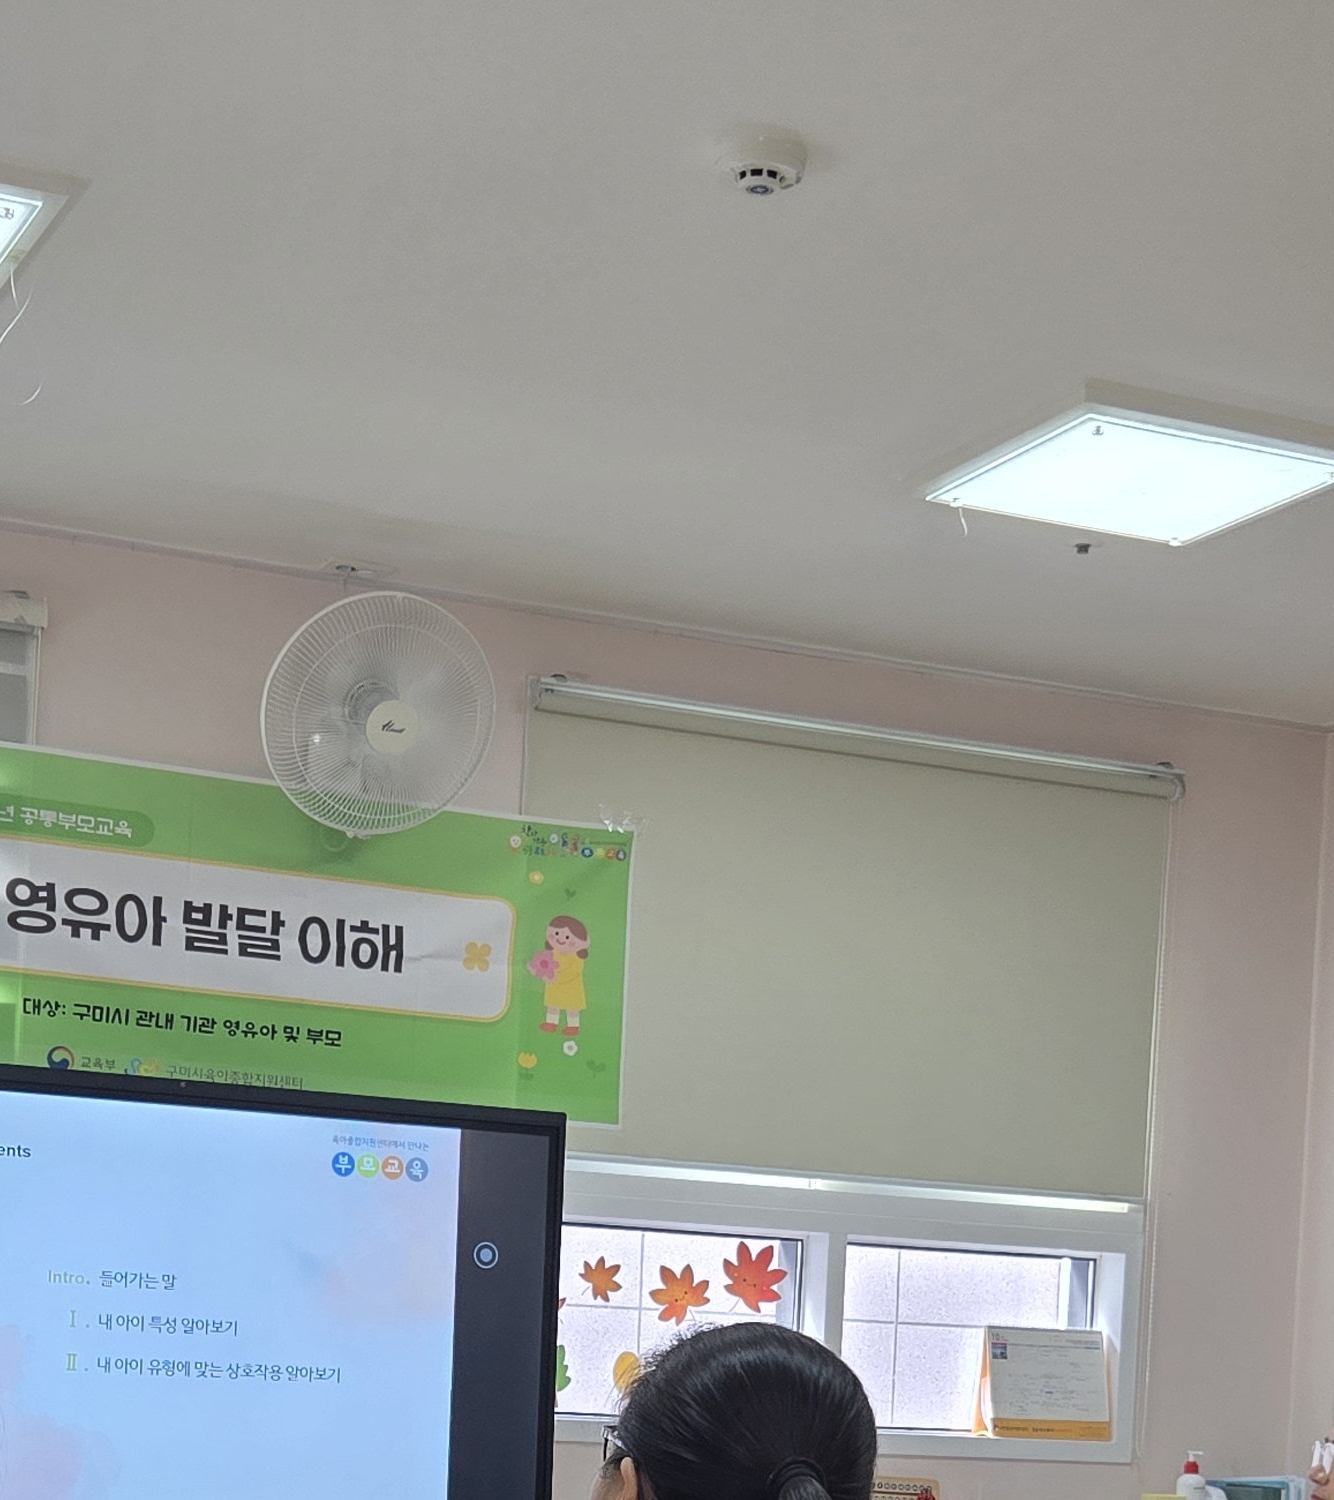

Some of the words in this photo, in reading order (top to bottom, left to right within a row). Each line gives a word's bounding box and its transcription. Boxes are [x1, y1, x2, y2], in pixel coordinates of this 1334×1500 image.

[19, 805, 133, 839] 공통부모교육
[5, 876, 167, 947] 영유아
[182, 900, 286, 962] 발달
[298, 915, 405, 974] 이해
[22, 997, 66, 1018] 대상:
[72, 1003, 130, 1027] 구미시
[135, 1009, 174, 1031] 관내
[179, 1014, 217, 1035] 기관
[223, 1019, 278, 1041] 영유아
[283, 1024, 301, 1044] 및
[305, 1027, 343, 1048] 부모
[80, 1056, 116, 1071] 교육부
[335, 1154, 425, 1180] 부모교육
[48, 1269, 91, 1285] Intro.
[99, 1270, 160, 1290] 들어가는
[161, 1273, 177, 1290] 말
[98, 1313, 113, 1331] 내
[116, 1314, 145, 1332] 아이
[147, 1316, 177, 1334] 특성
[181, 1317, 238, 1336] 알아보기
[97, 1356, 112, 1375] 내
[114, 1357, 143, 1376] 아이
[147, 1359, 191, 1378] 유형에
[194, 1360, 224, 1379] 맞는
[225, 1362, 284, 1381] 상호작용
[285, 1364, 342, 1384] 알아보기
